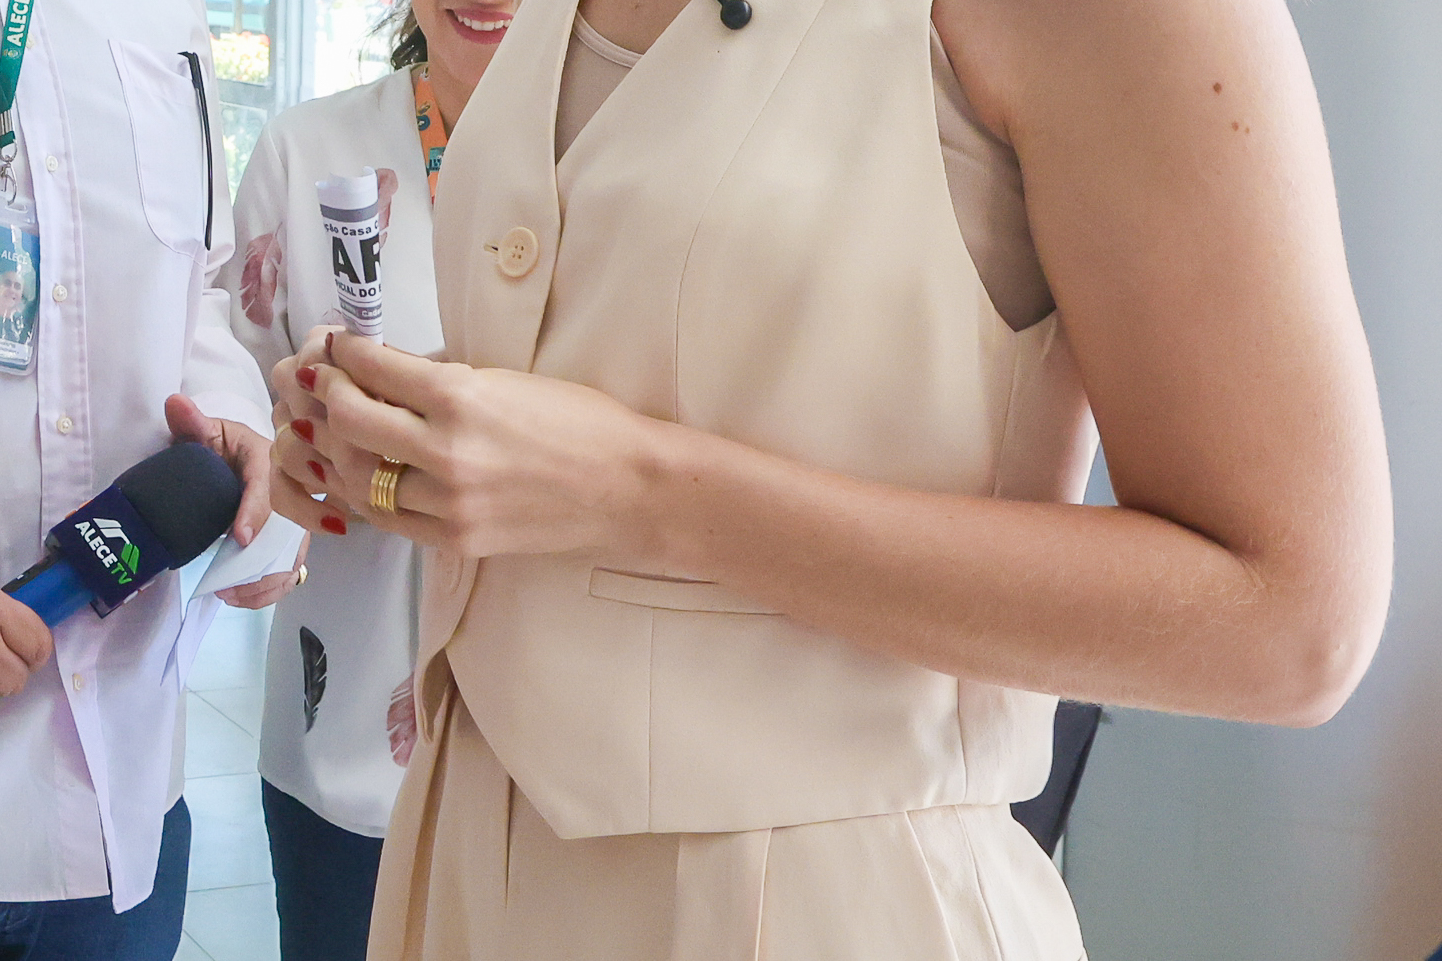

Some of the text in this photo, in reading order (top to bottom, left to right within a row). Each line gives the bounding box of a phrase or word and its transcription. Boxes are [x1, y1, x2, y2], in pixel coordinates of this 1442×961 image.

[341, 225, 372, 237] Casa
[358, 287, 377, 298] DO
[74, 521, 119, 569] ALECE
